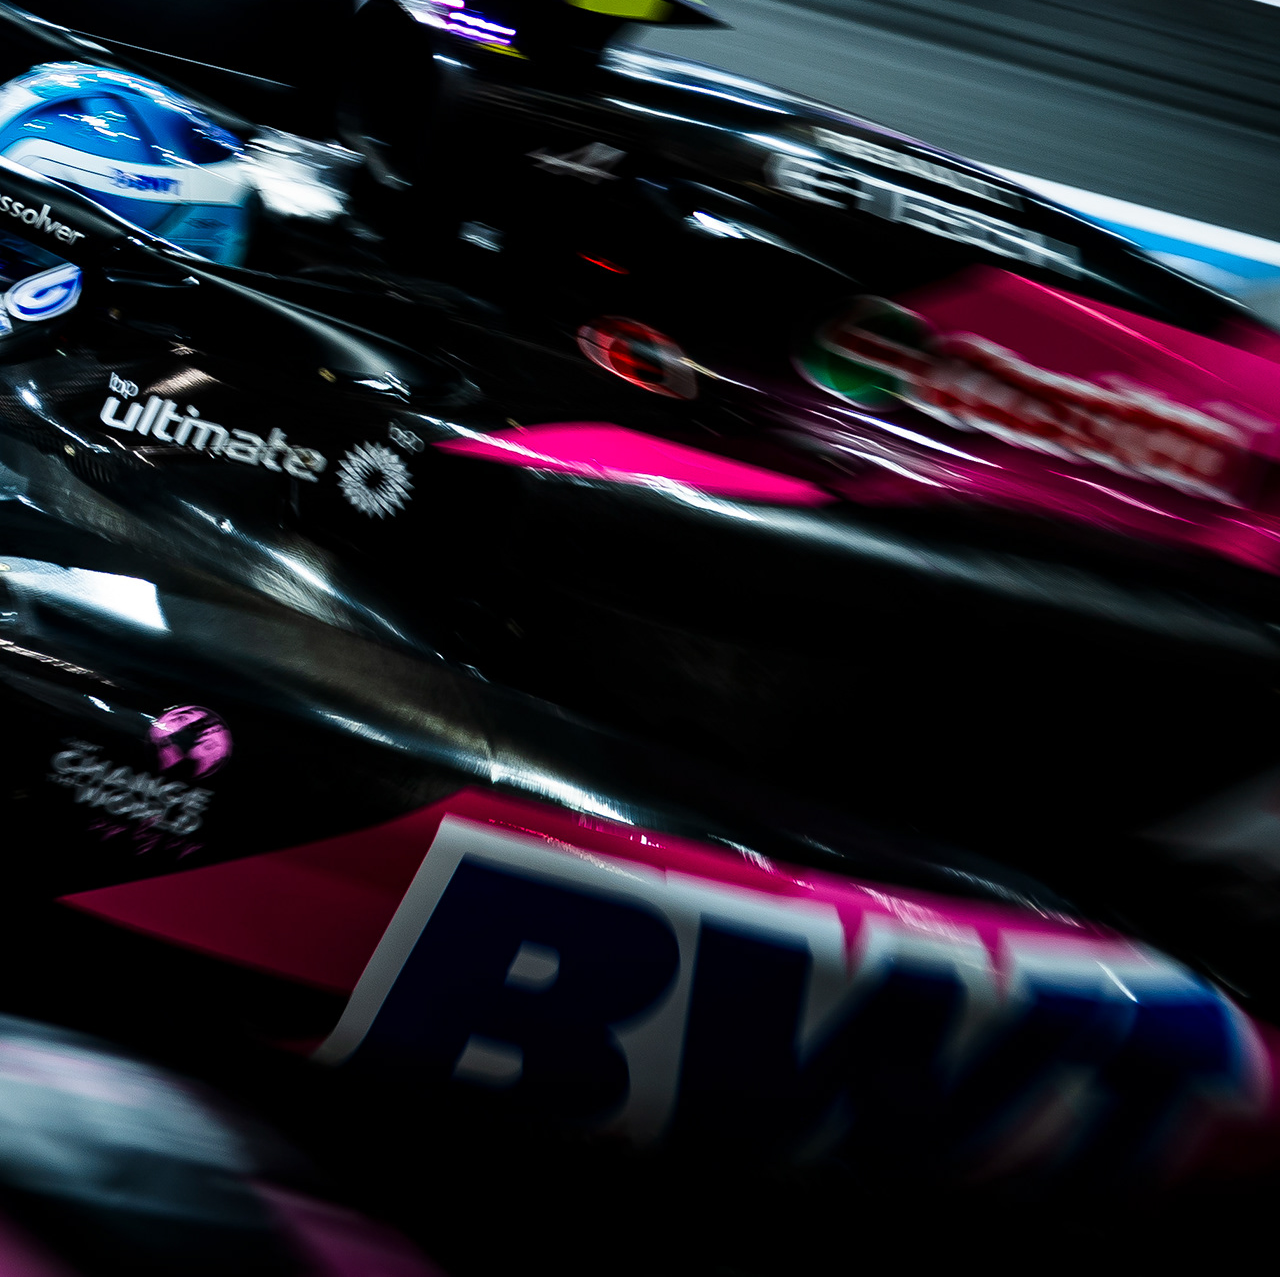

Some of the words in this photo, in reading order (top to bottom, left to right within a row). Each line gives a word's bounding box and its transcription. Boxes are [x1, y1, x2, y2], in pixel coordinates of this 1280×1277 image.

[109, 372, 139, 399] bp
[100, 394, 328, 483] ultimate
[350, 856, 1243, 1197] BWT
